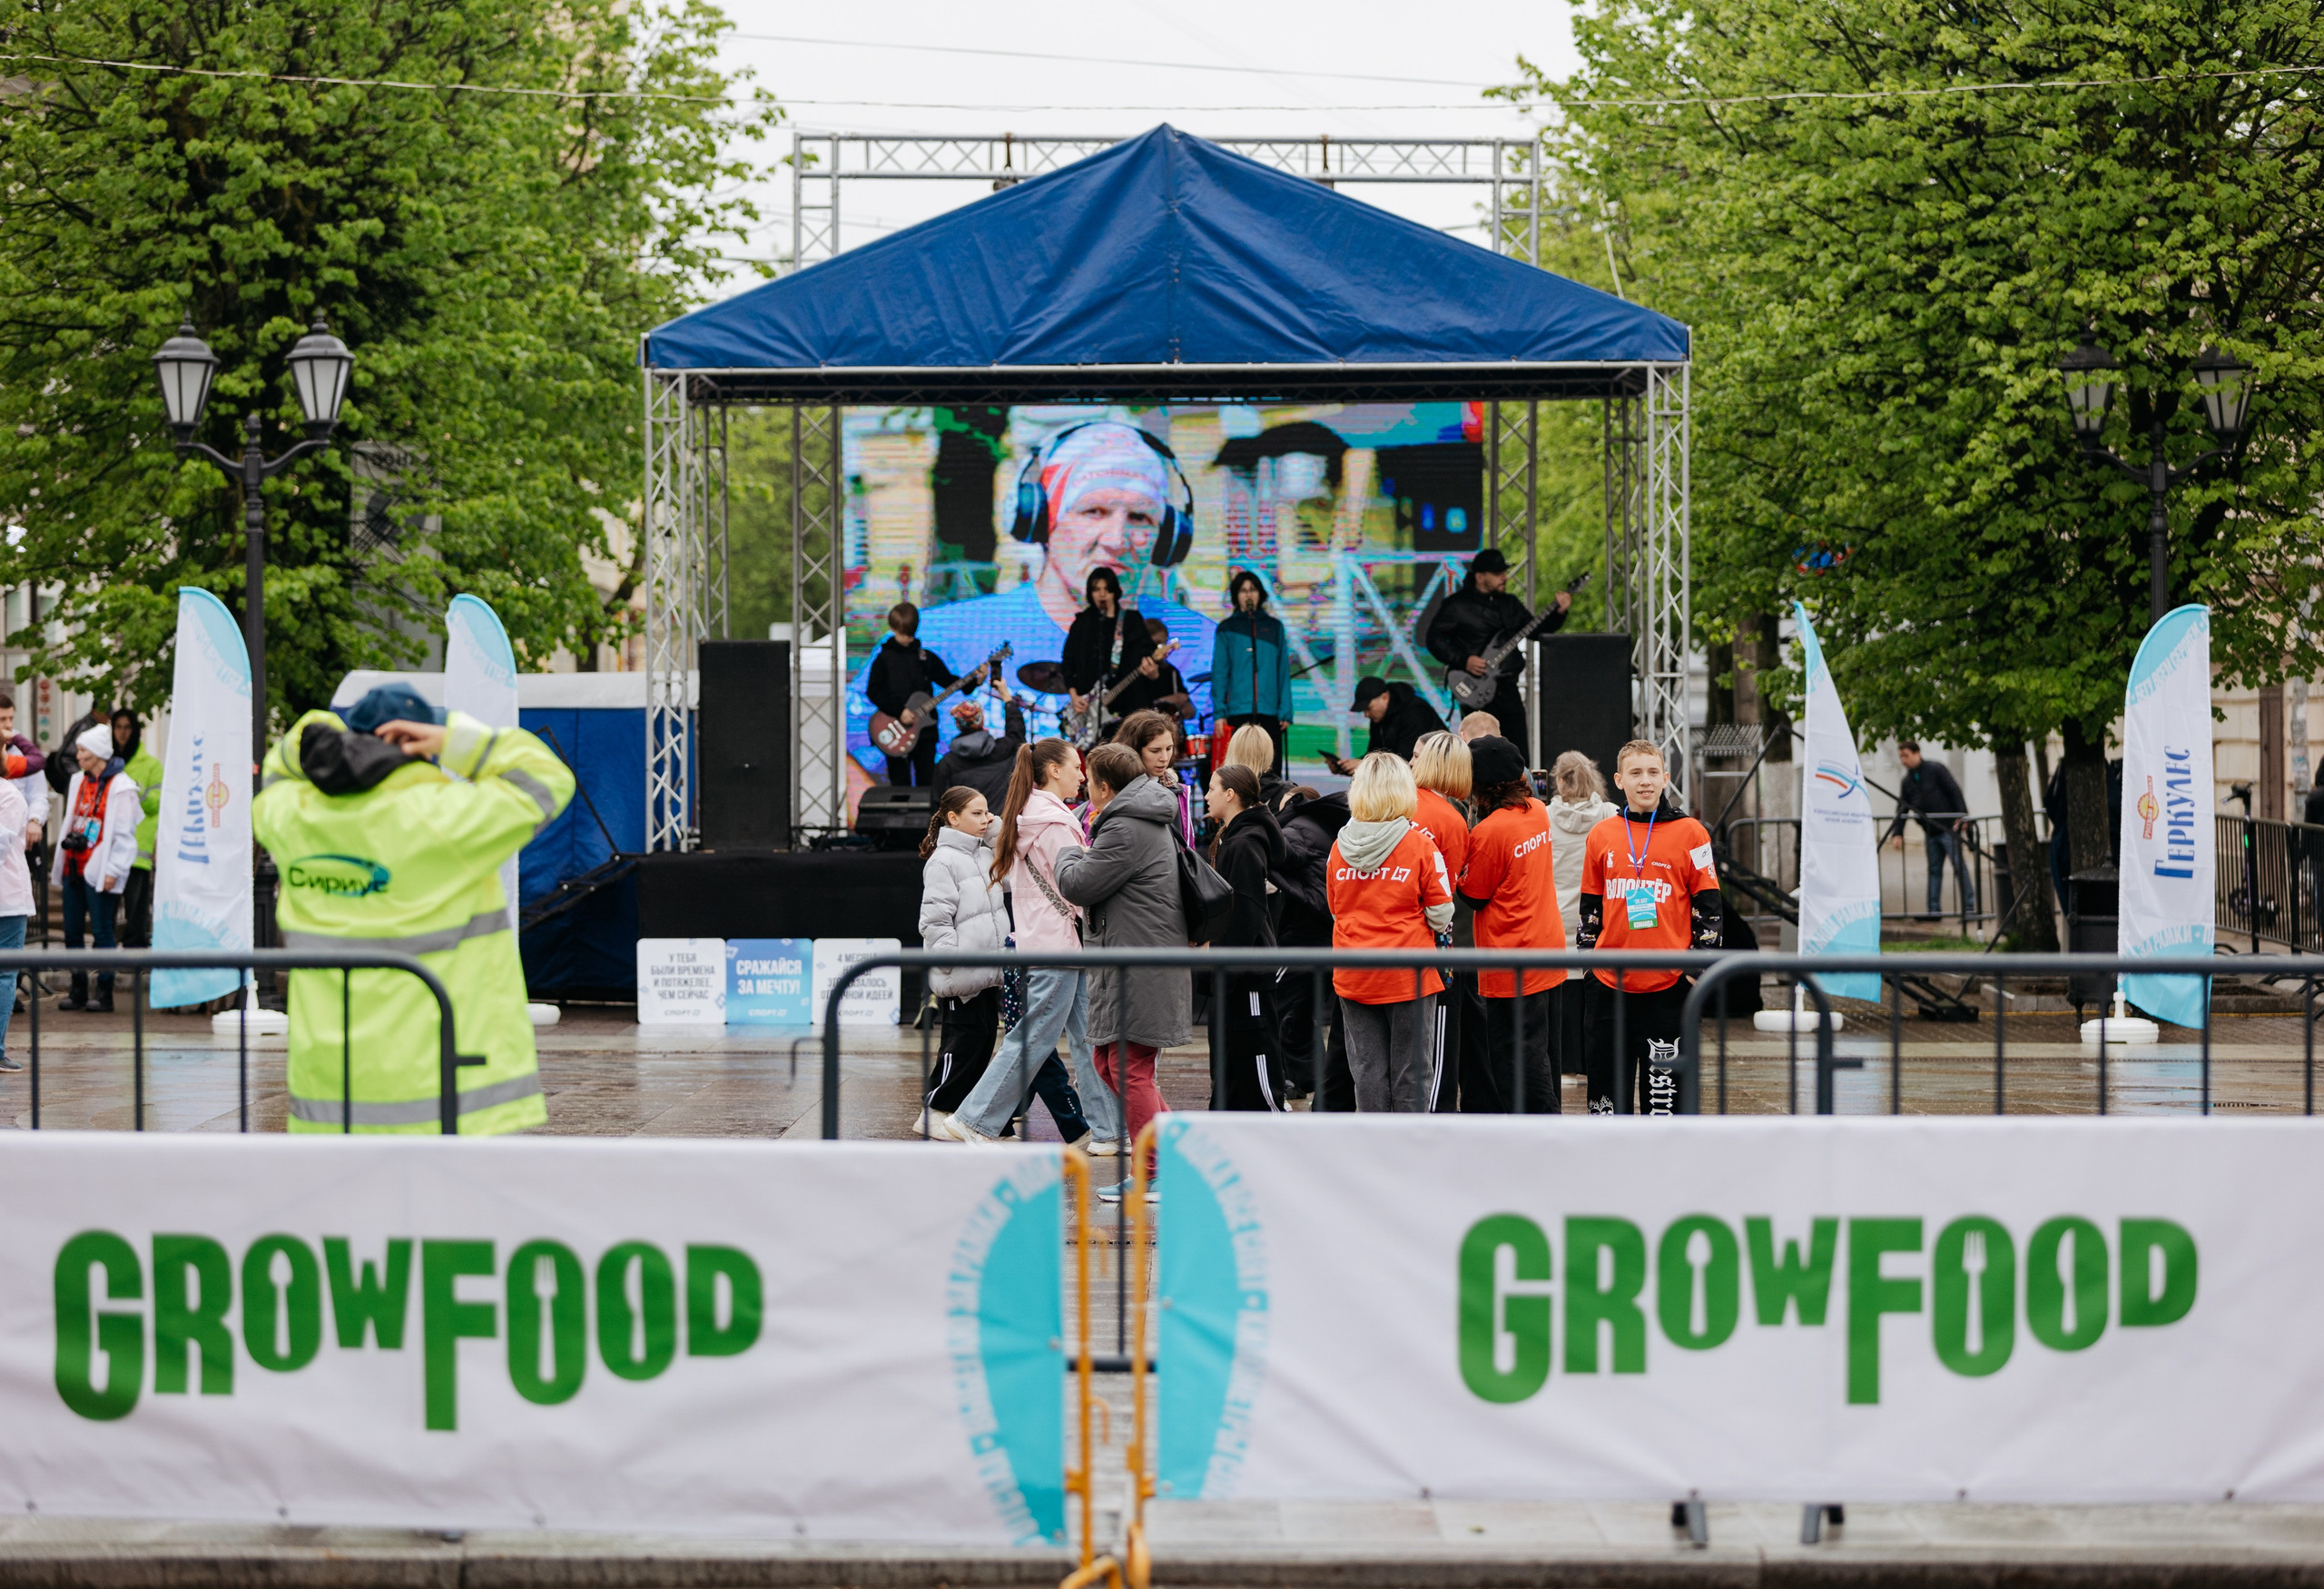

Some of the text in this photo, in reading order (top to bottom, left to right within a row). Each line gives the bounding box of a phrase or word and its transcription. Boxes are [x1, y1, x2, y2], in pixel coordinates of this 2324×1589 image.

[1514, 831, 1547, 858] СПОРТ
[289, 867, 389, 897] Сириус
[1335, 865, 1412, 883] СПОРТ 47
[2152, 924, 2192, 952] РАМКИ
[669, 952, 697, 962] У ТЕБЯ
[651, 965, 715, 975] БЫЛИ ВРЕМЕНА
[736, 957, 803, 976] СРАЖАЙСЯ
[654, 977, 659, 987] И
[737, 979, 801, 995] ЗА МЕЧТУ!
[658, 988, 709, 1000] ЧЕМ СЕЙЧАС
[821, 988, 863, 1000] ОТЧНОЙ
[1457, 1212, 2198, 1406] GROWFOOD
[54, 1229, 763, 1432] GROWFOOD
